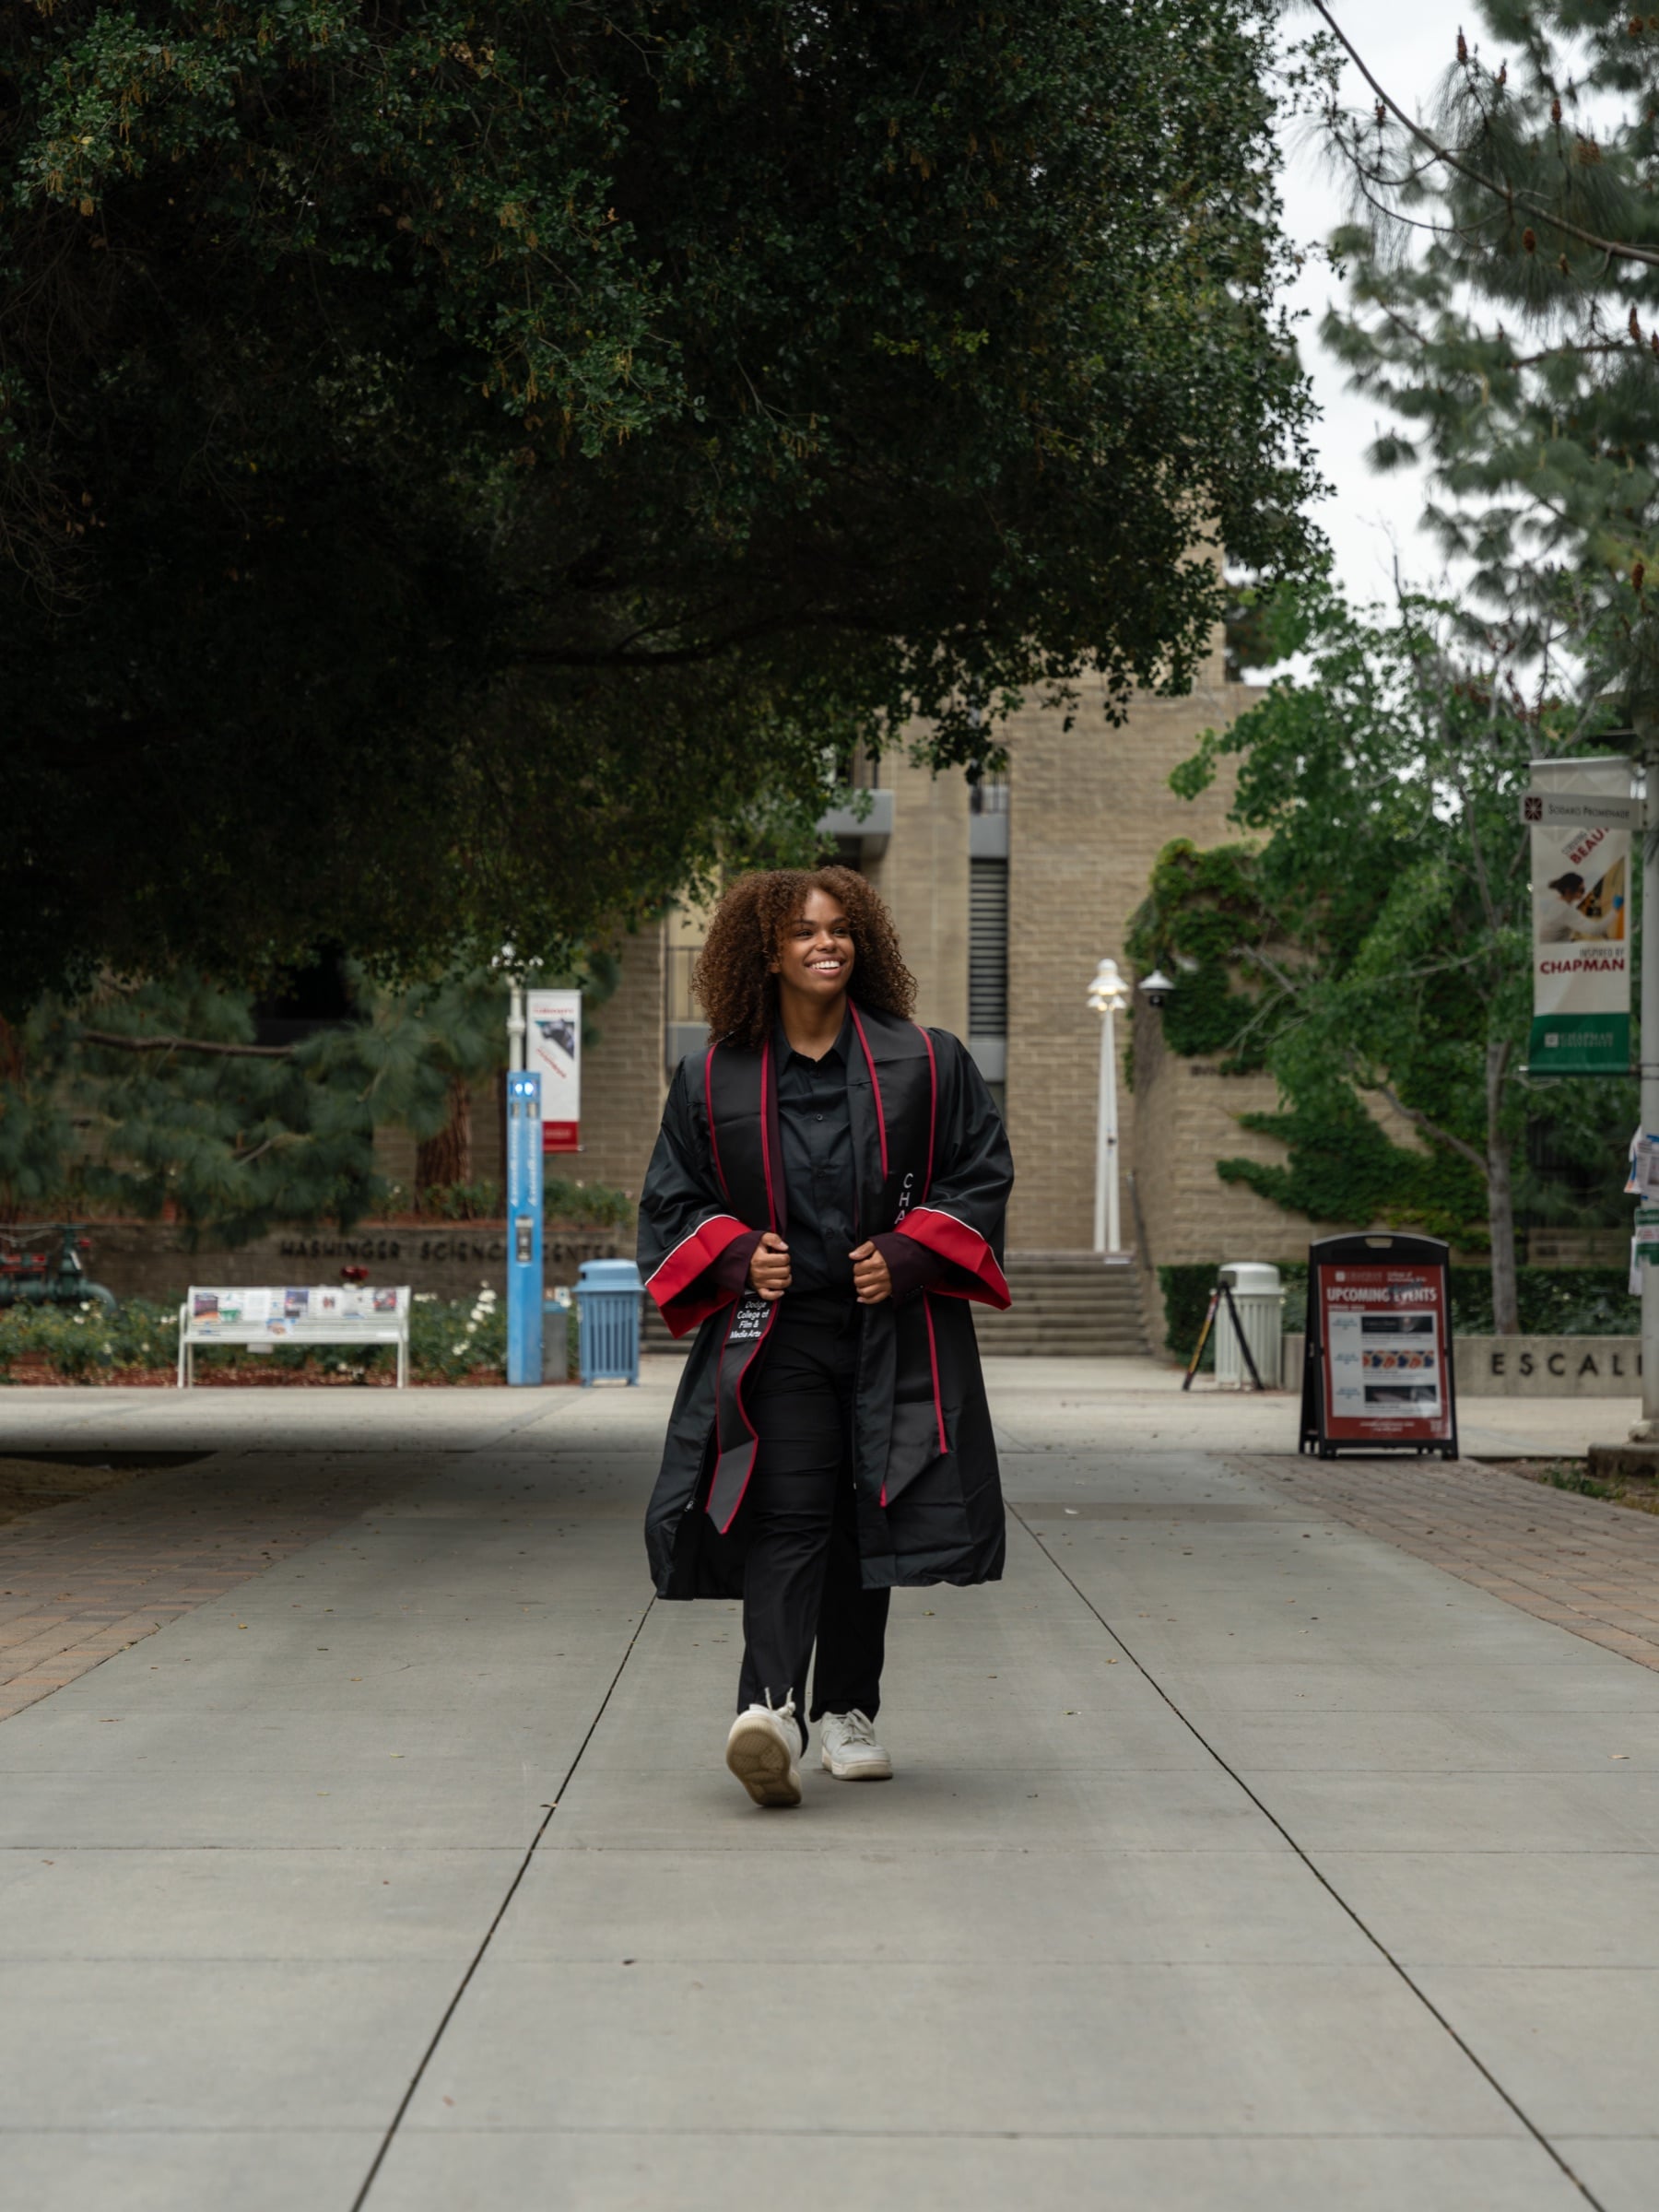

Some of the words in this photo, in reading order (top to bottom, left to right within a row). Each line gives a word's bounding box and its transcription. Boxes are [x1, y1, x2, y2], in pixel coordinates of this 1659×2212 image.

[1570, 827, 1610, 865] BEAU
[1539, 959, 1625, 974] CHAPMAN
[280, 1240, 401, 1259] HASHINGER
[419, 1241, 507, 1262] SCIENC
[1326, 1286, 1390, 1302] UPCOMING
[1394, 1286, 1438, 1302] EVENTS
[745, 1301, 766, 1310] Dodge
[737, 1311, 760, 1320] College
[761, 1309, 769, 1318] of
